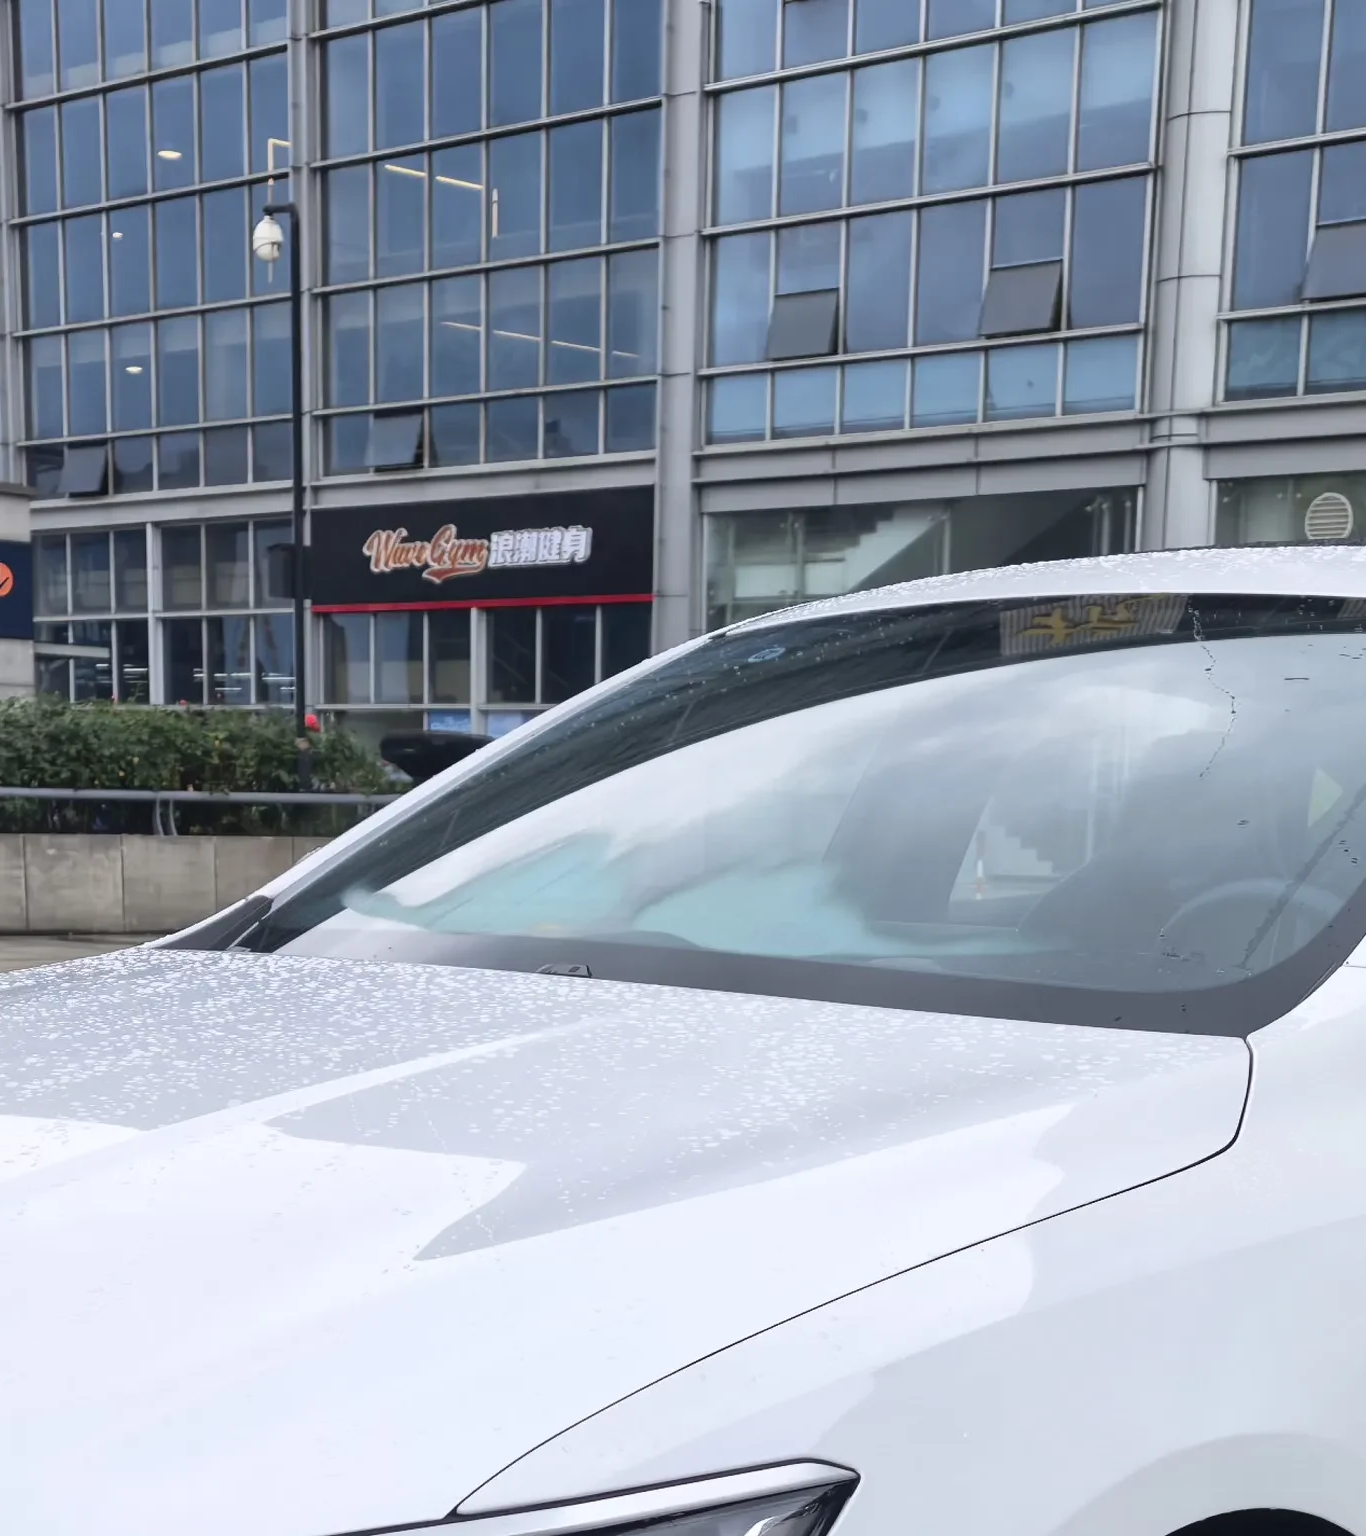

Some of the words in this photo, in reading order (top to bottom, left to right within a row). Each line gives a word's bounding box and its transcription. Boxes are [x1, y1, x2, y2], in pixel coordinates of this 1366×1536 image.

[423, 523, 488, 584] Gym
[487, 525, 592, 569] 浪潮健身
